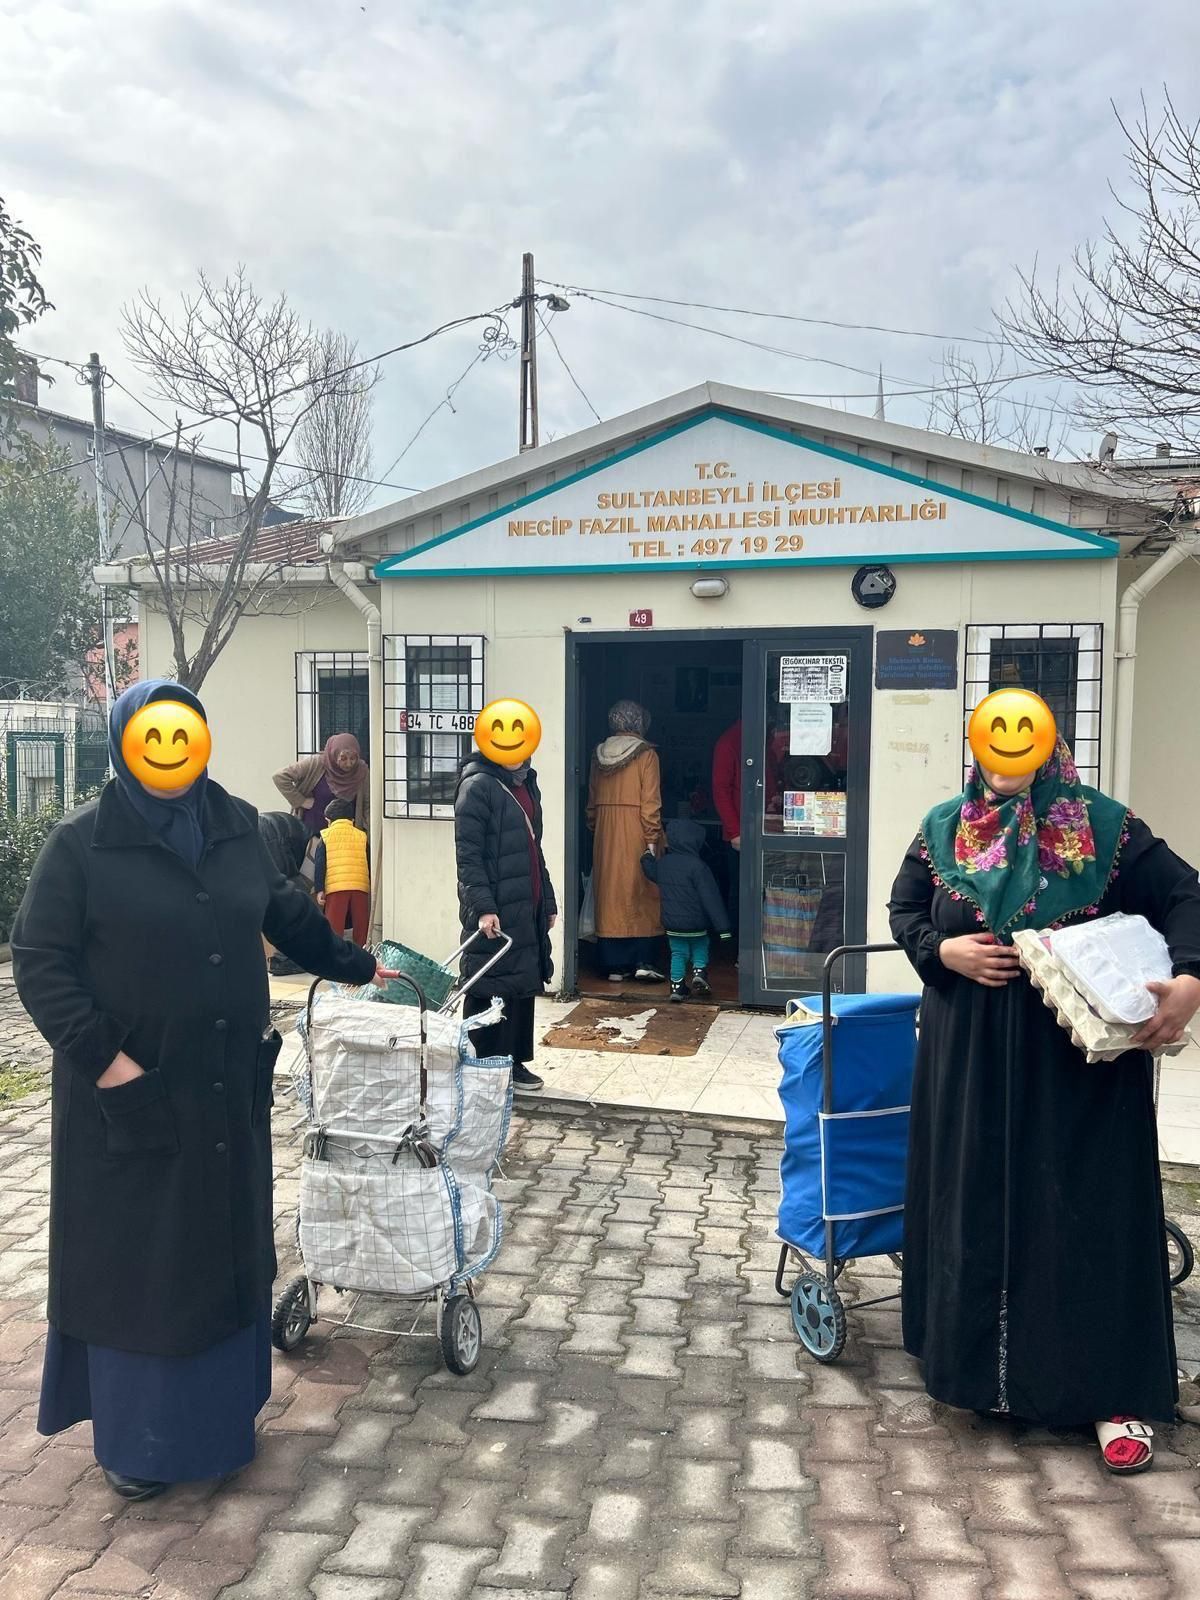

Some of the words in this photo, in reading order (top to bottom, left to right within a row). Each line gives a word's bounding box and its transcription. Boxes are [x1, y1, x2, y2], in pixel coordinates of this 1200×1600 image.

[695, 462, 737, 480] T.C.
[597, 482, 754, 510] SULTANBEYLİ
[762, 478, 841, 505] İLÇESİ
[508, 516, 573, 537] NECİP
[579, 516, 641, 535] FAZIL
[647, 506, 781, 533] MAHALLESİ
[788, 499, 947, 526] MUHTARLIĞI
[629, 540, 672, 557] TEL
[690, 538, 733, 556] 497
[740, 536, 768, 553] 19
[774, 534, 804, 553] 29
[634, 613, 647, 624] 49
[821, 656, 845, 665] TEKSTİL
[408, 713, 421, 729] 34
[429, 714, 443, 730] TC
[451, 714, 478, 731] 488
